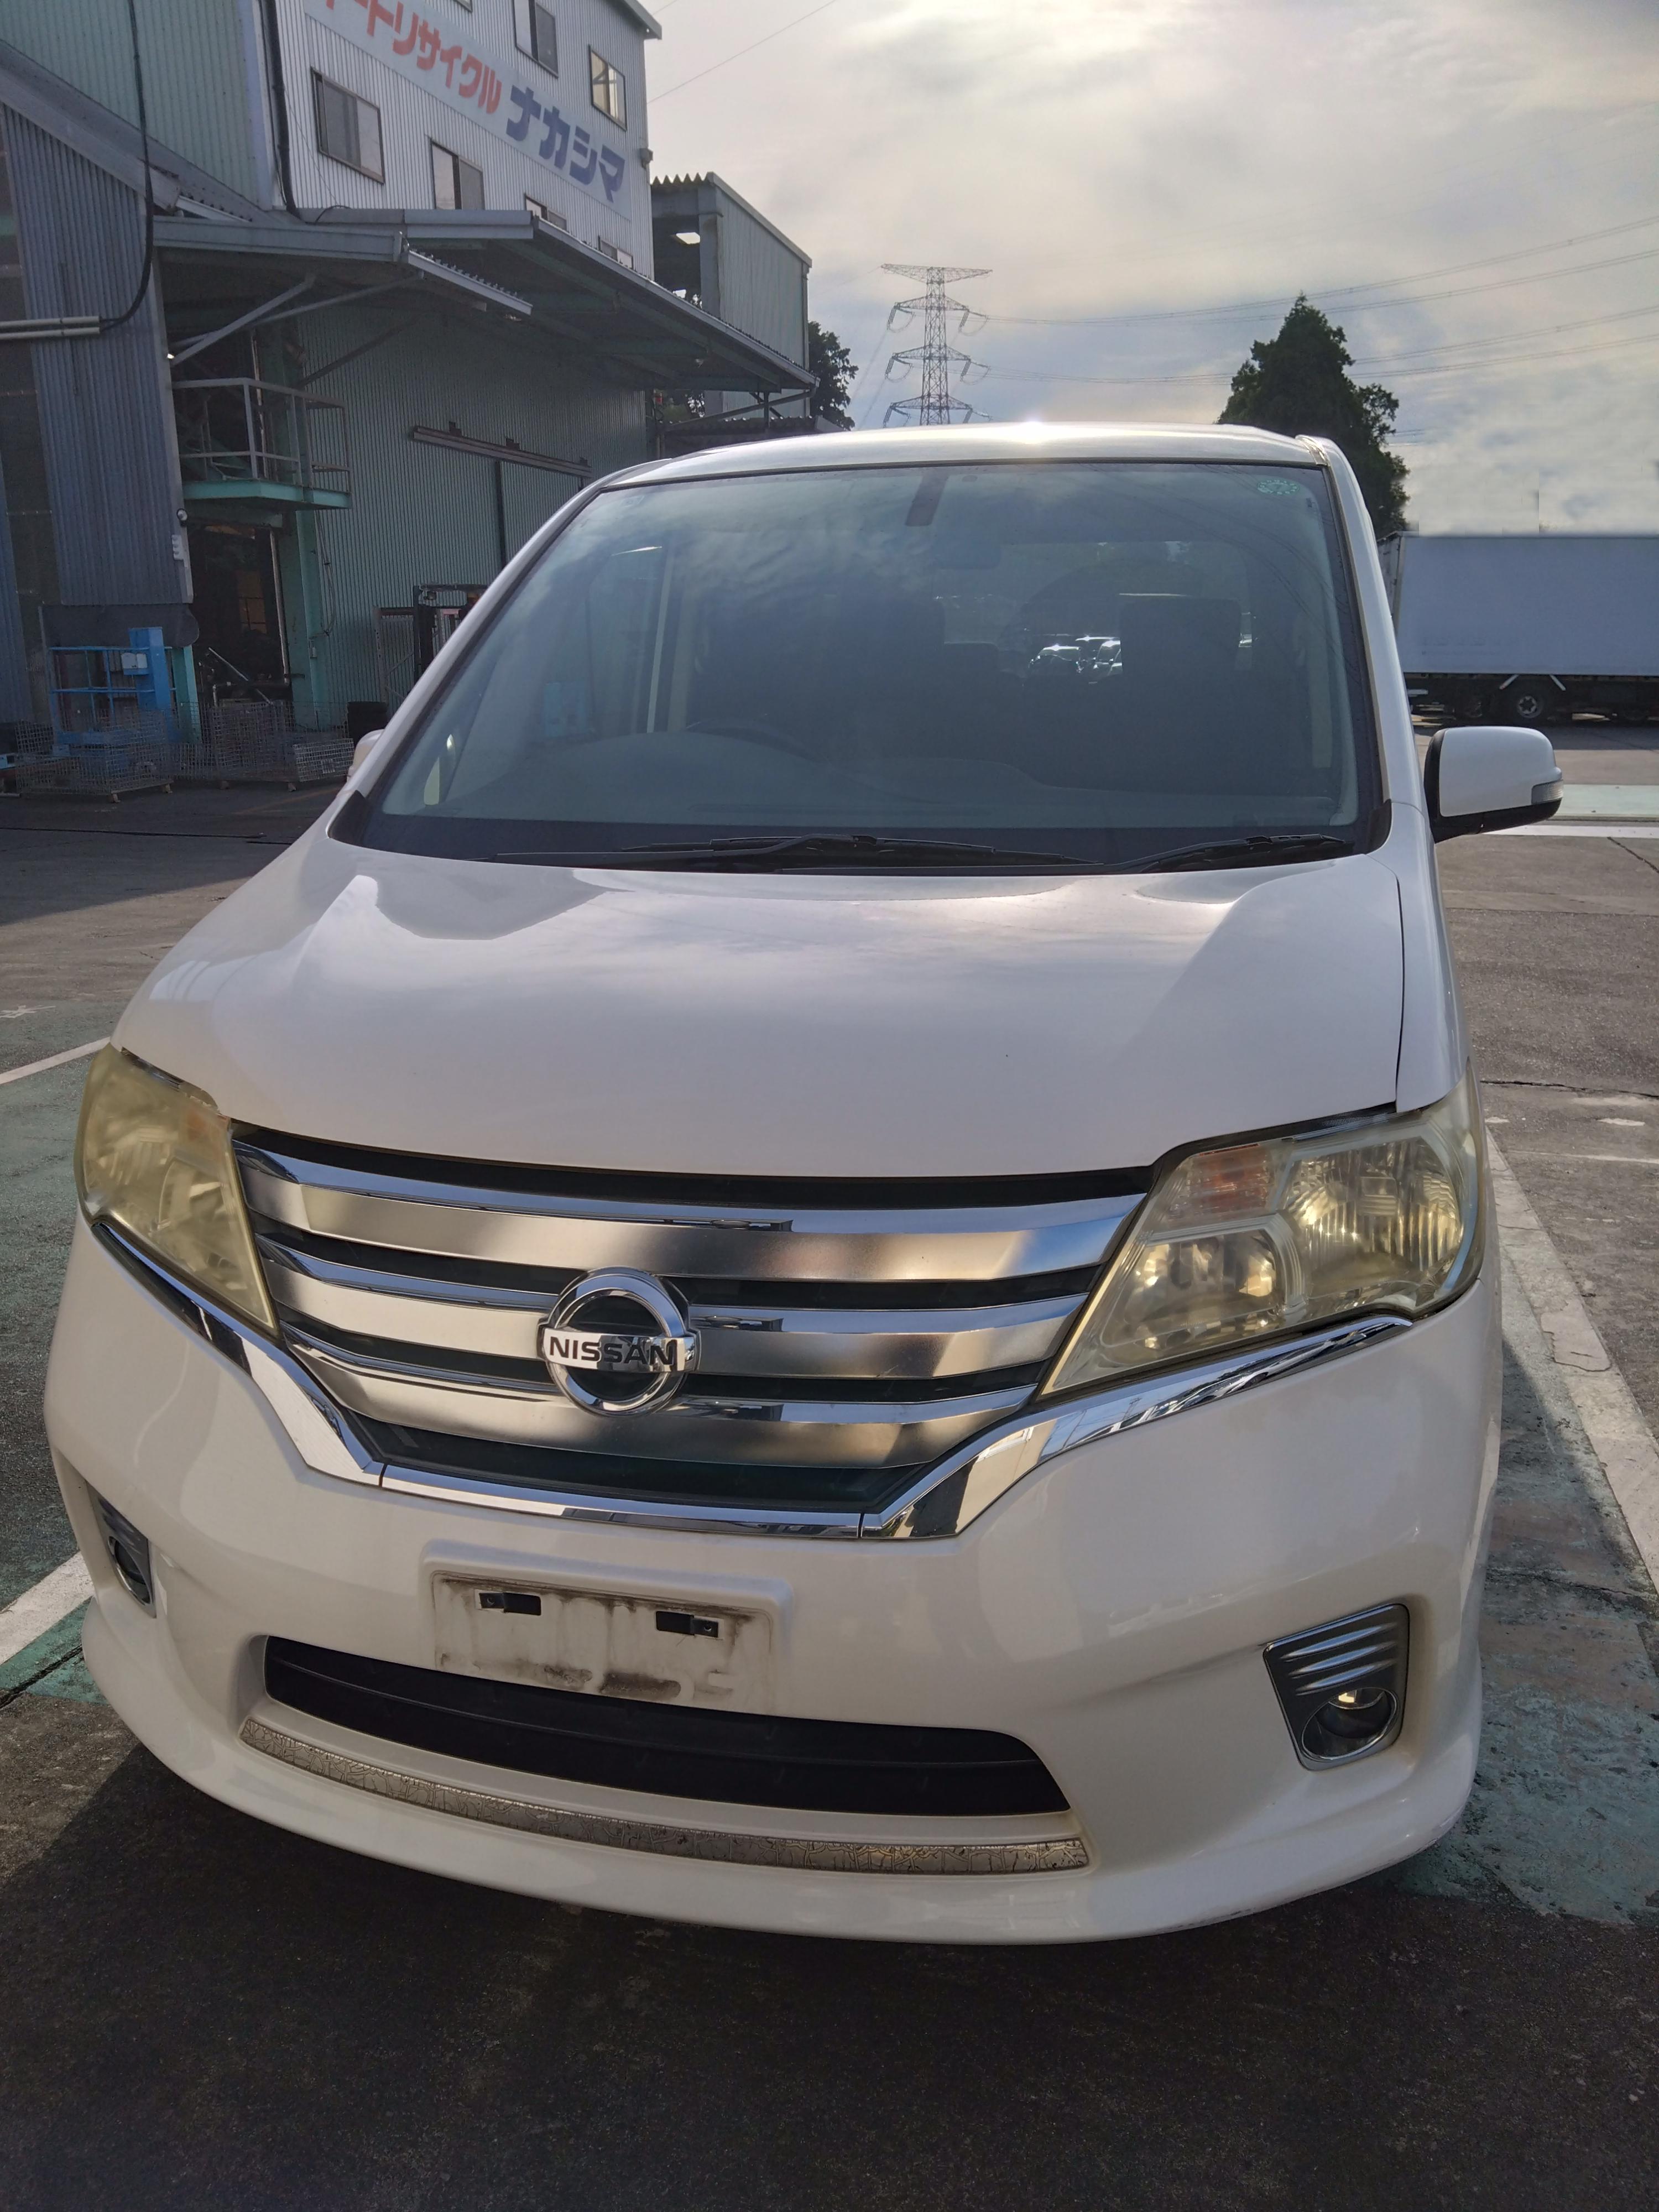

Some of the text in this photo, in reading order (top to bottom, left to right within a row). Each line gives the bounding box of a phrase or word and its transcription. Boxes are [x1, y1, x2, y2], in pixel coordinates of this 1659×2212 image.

[506, 84, 625, 204] ナカシマ
[549, 1335, 678, 1366] NISSAN
